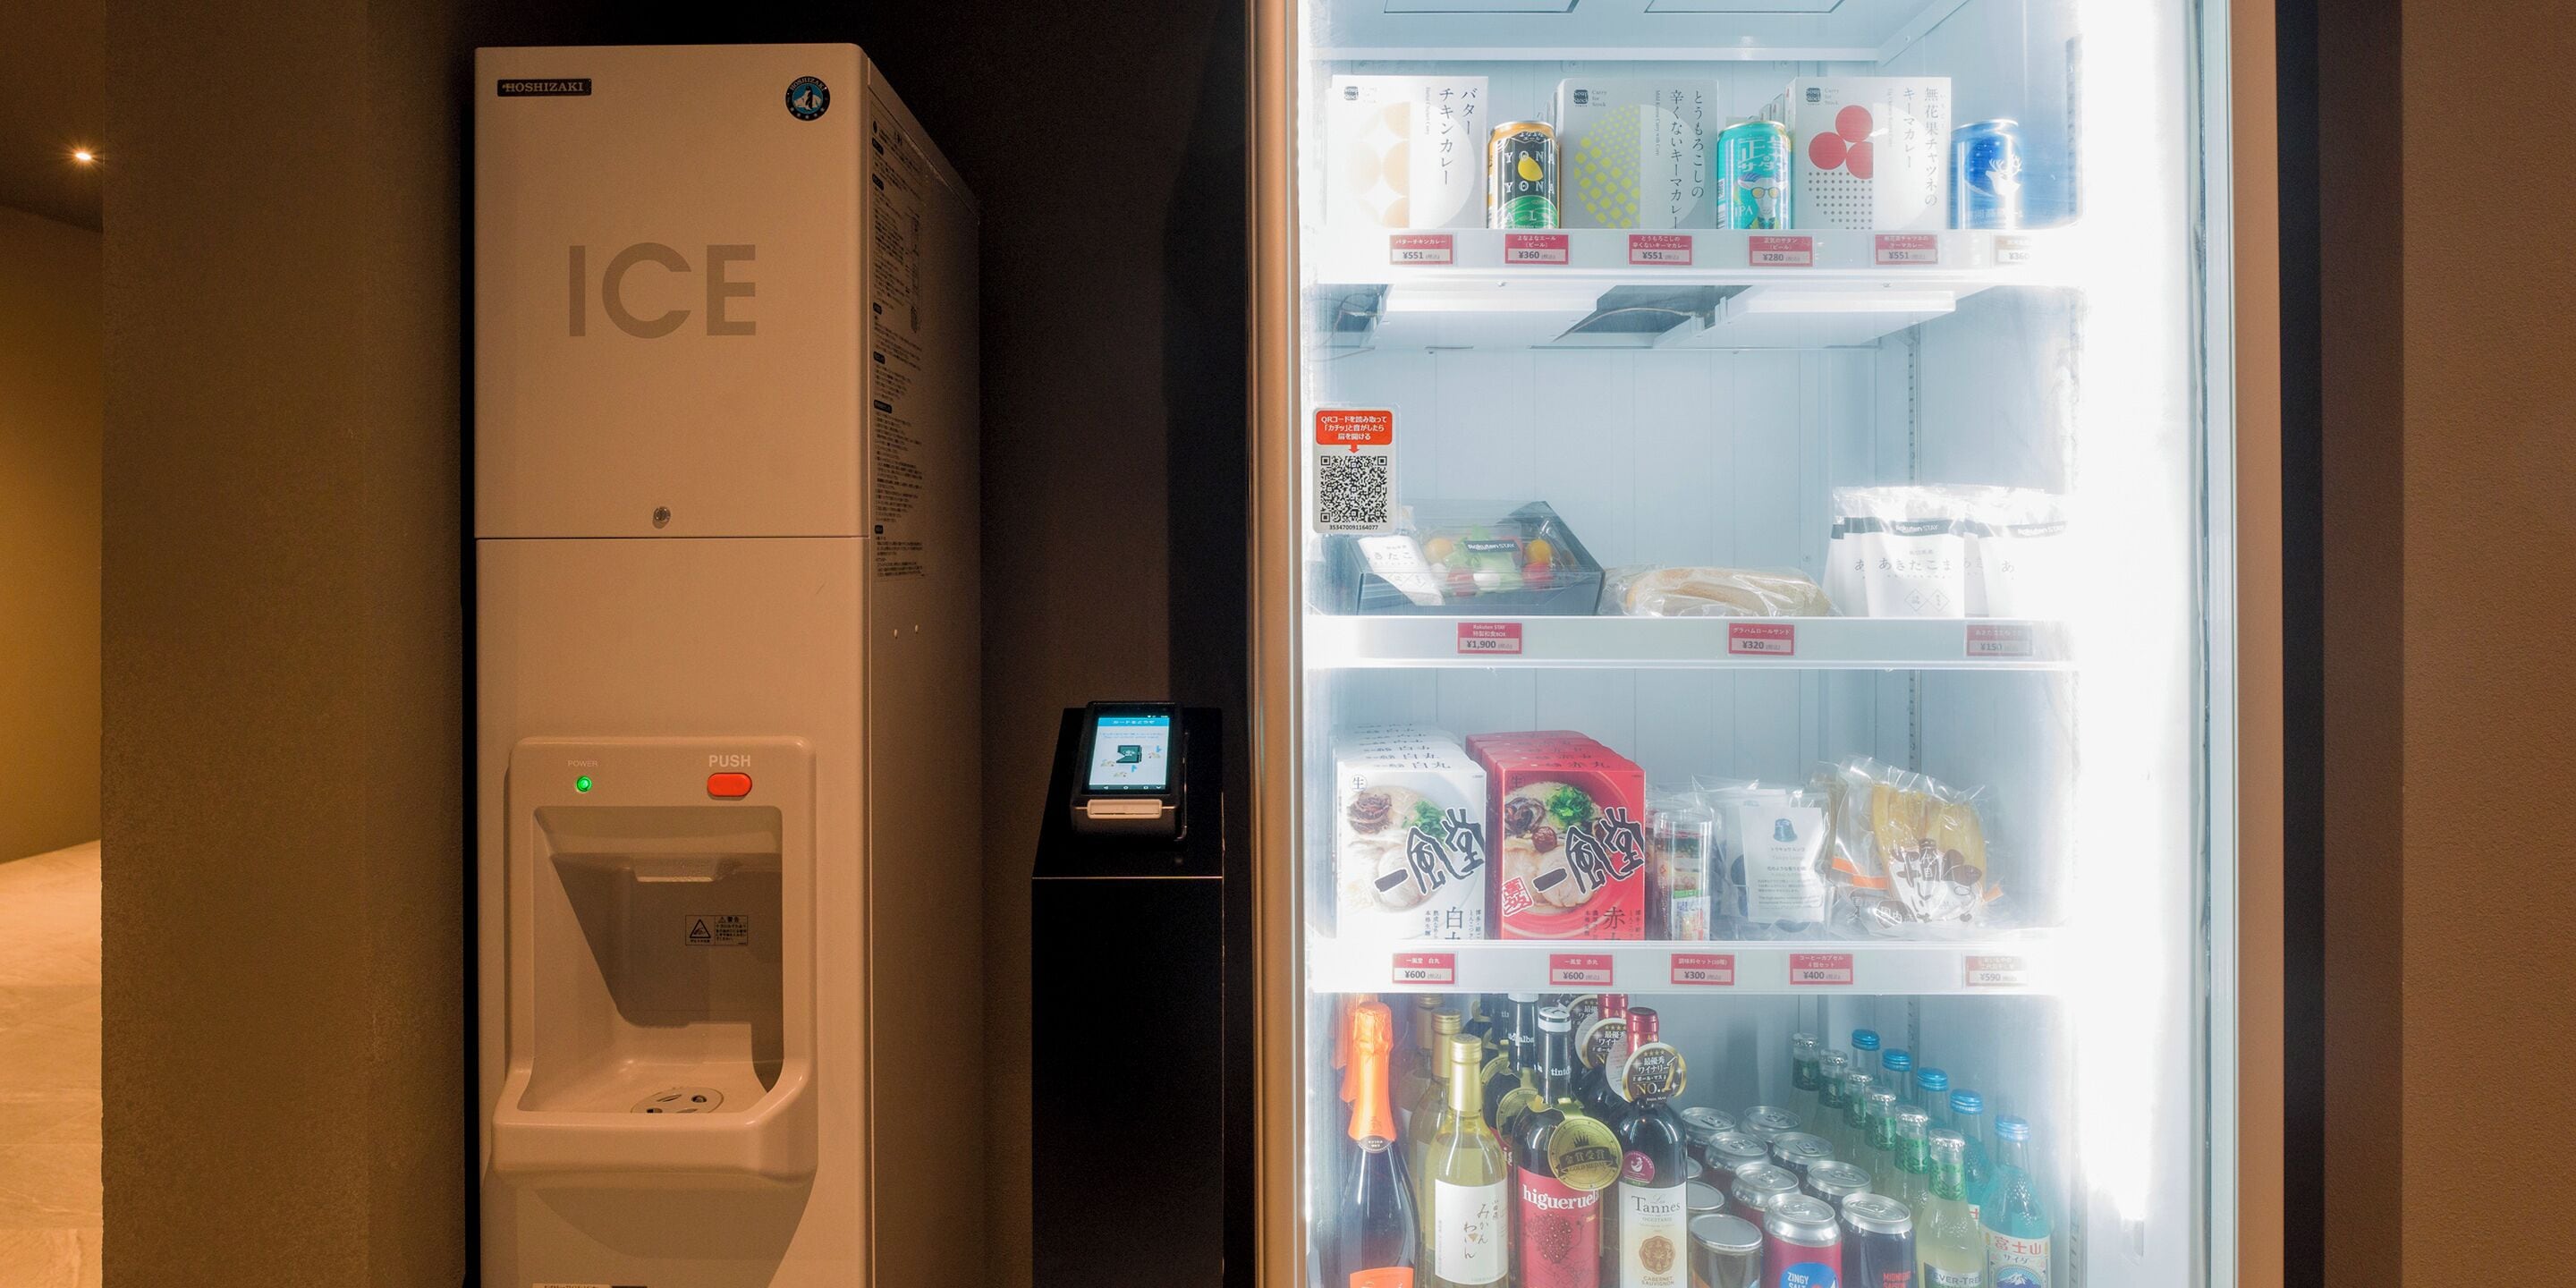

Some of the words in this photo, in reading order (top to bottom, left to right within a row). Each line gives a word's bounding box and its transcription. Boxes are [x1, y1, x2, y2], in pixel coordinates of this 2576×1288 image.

[503, 81, 583, 93] HOSHIZAKI
[1462, 88, 1478, 135] バター
[1903, 88, 1915, 168] キーマカレー
[1439, 88, 1454, 185] チキンカレー
[1691, 90, 1704, 199] とうもろこしの
[1924, 88, 1939, 206] 無花果チャツネの
[1504, 150, 1555, 165] YONA
[1670, 89, 1683, 229] 辛くないキーマカレー
[1504, 181, 1555, 195] YONA
[1402, 251, 1423, 259] ¥551
[1518, 250, 1540, 259] ¥360
[1642, 251, 1663, 259] ¥551
[1762, 253, 1784, 261] ¥280
[1888, 251, 1910, 259] ¥551
[569, 242, 757, 339] ICE
[1467, 640, 1496, 649] ¥1,900
[1742, 640, 1764, 649] ¥320
[708, 754, 751, 767] PUSH
[1374, 808, 1486, 894] 一風堂
[1532, 807, 1646, 894] 一風堂
[1404, 970, 1426, 979] ¥600
[1563, 971, 1584, 979] ¥600
[1684, 971, 1706, 979] ¥300
[1803, 971, 1825, 979] ¥400
[1644, 1055, 1665, 1065] 最優秀
[1639, 1064, 1670, 1073] ワイナリー
[1631, 1195, 1681, 1213] Tannes
[1994, 1235, 2042, 1256] 富士山
[1787, 1271, 1809, 1285] ZINGY
